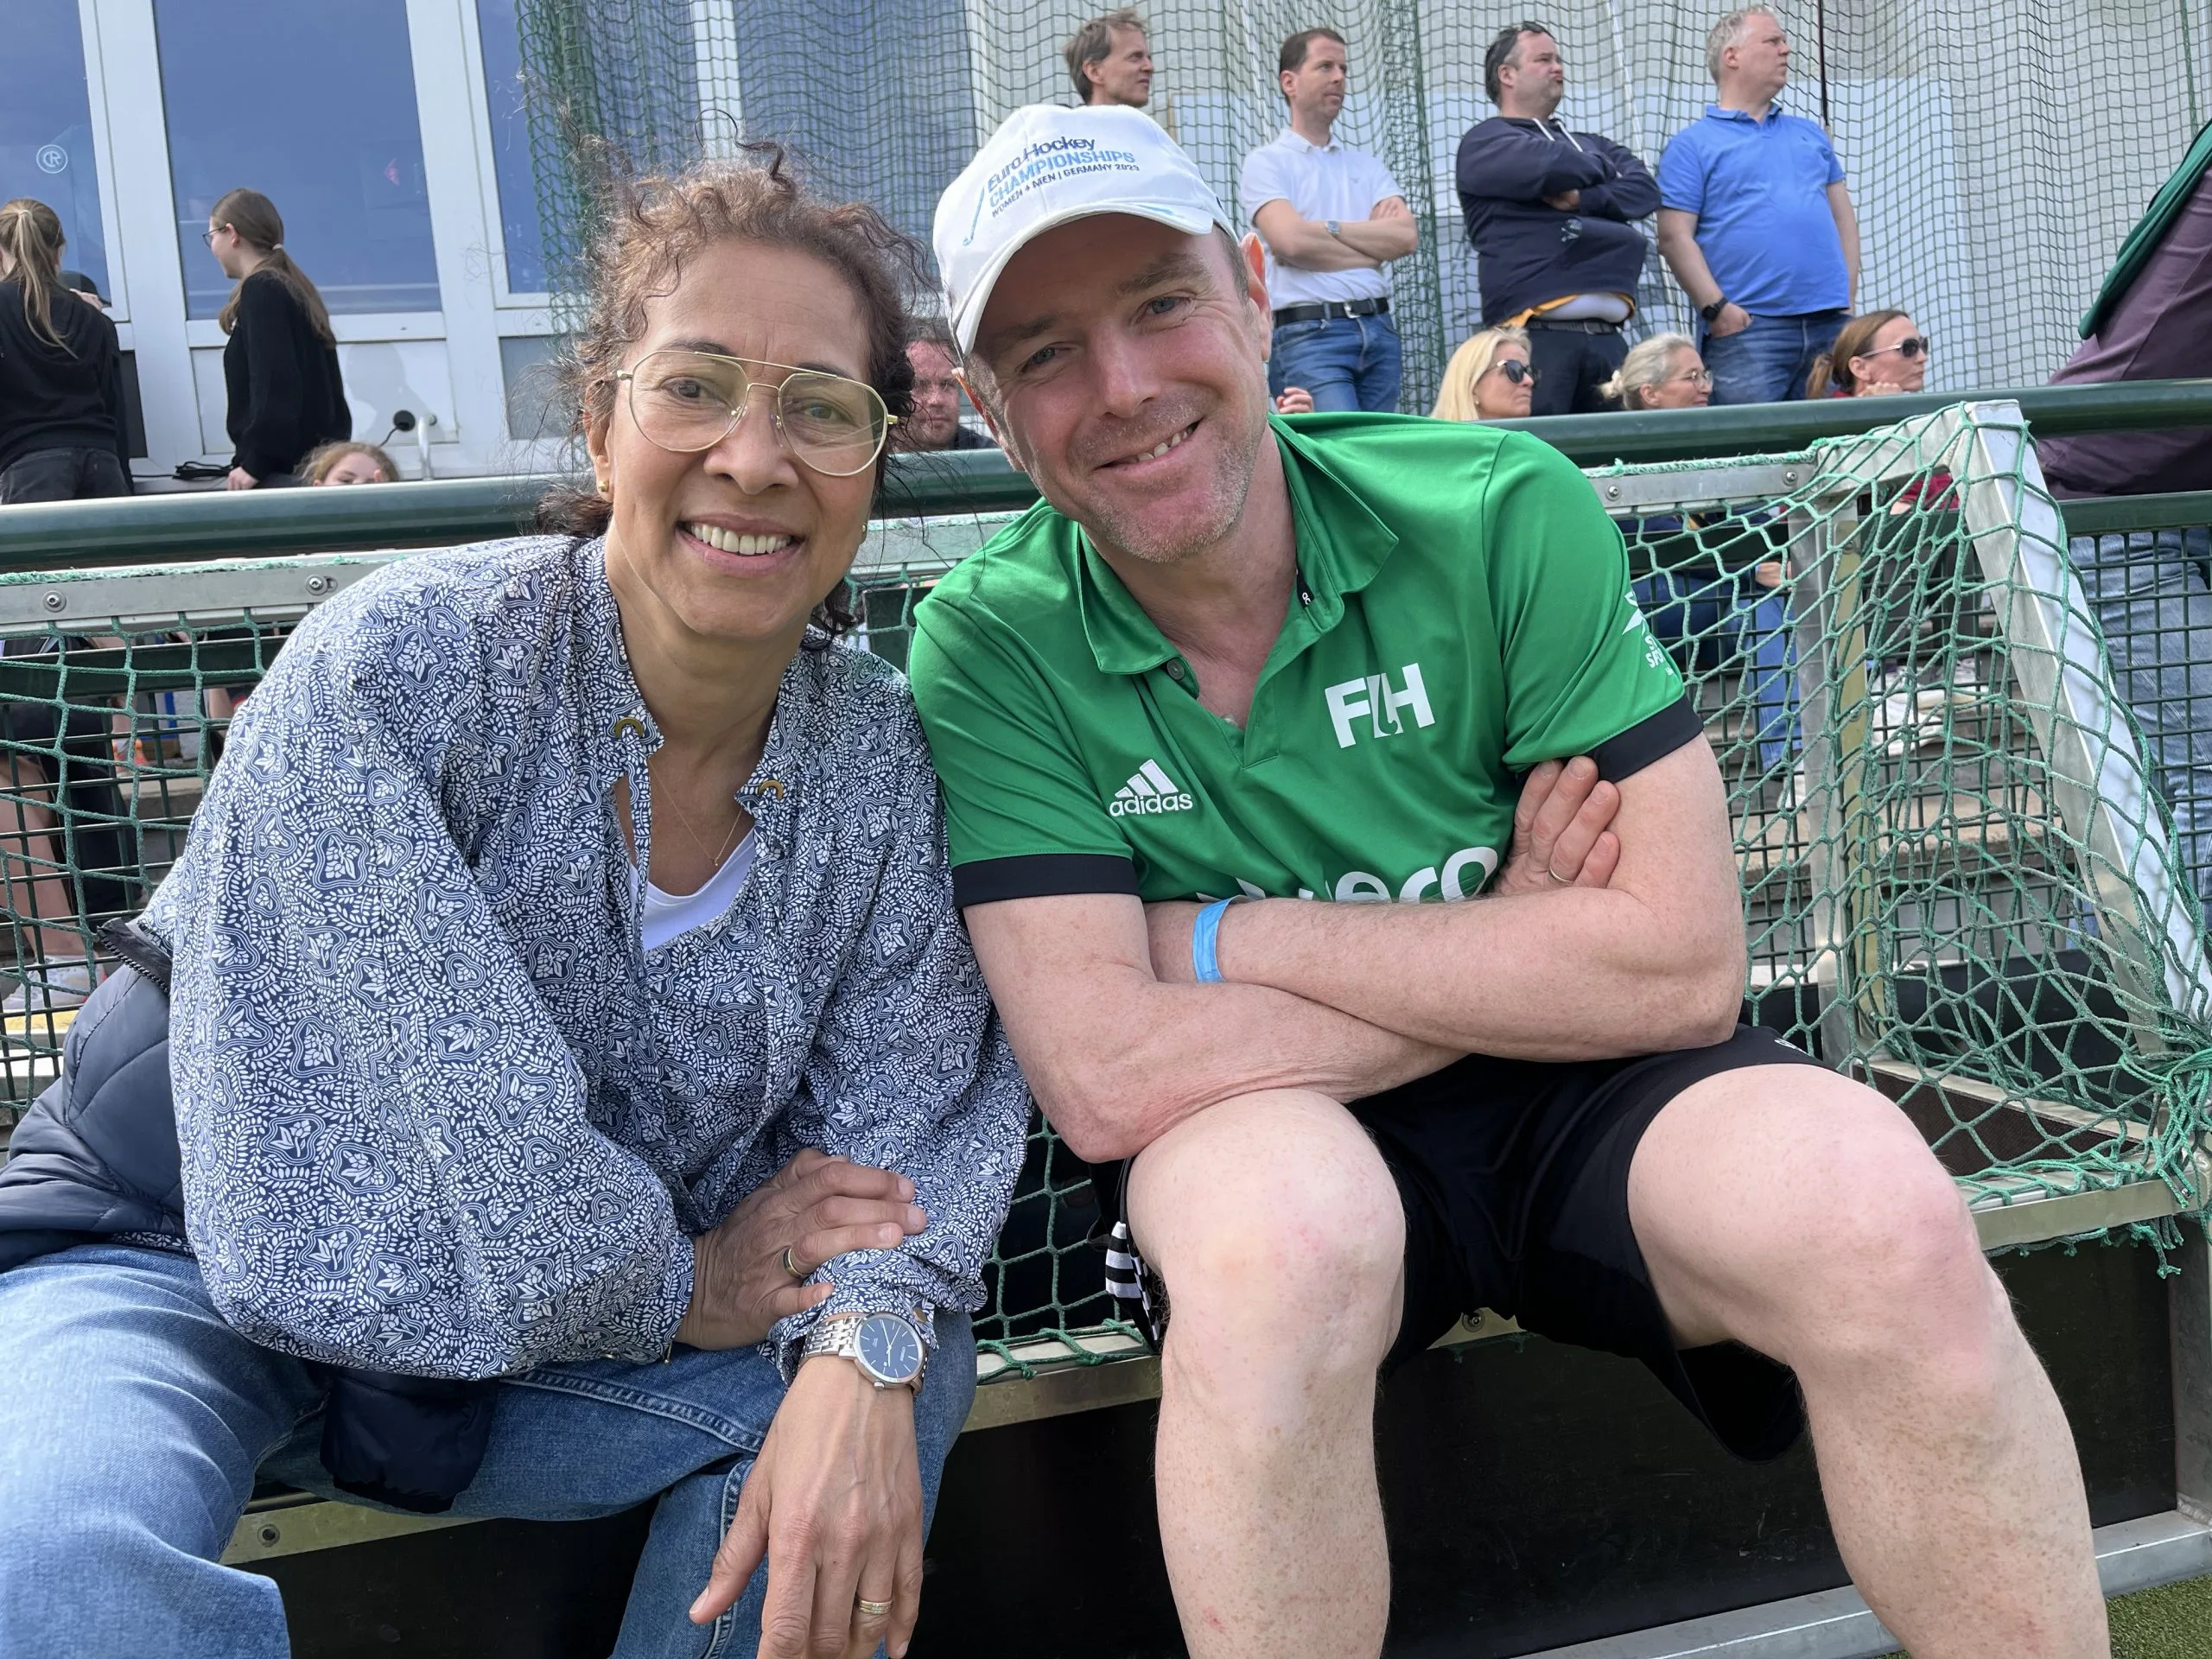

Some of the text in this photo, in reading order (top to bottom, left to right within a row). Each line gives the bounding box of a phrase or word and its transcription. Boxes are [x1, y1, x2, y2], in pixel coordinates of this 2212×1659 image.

[989, 149, 1136, 207] CHAMPIONSHIPS
[991, 190, 1023, 218] WOMEN
[1032, 173, 1056, 189] MEN
[1063, 163, 1112, 177] GERMANY
[1109, 791, 1193, 817] adidas
